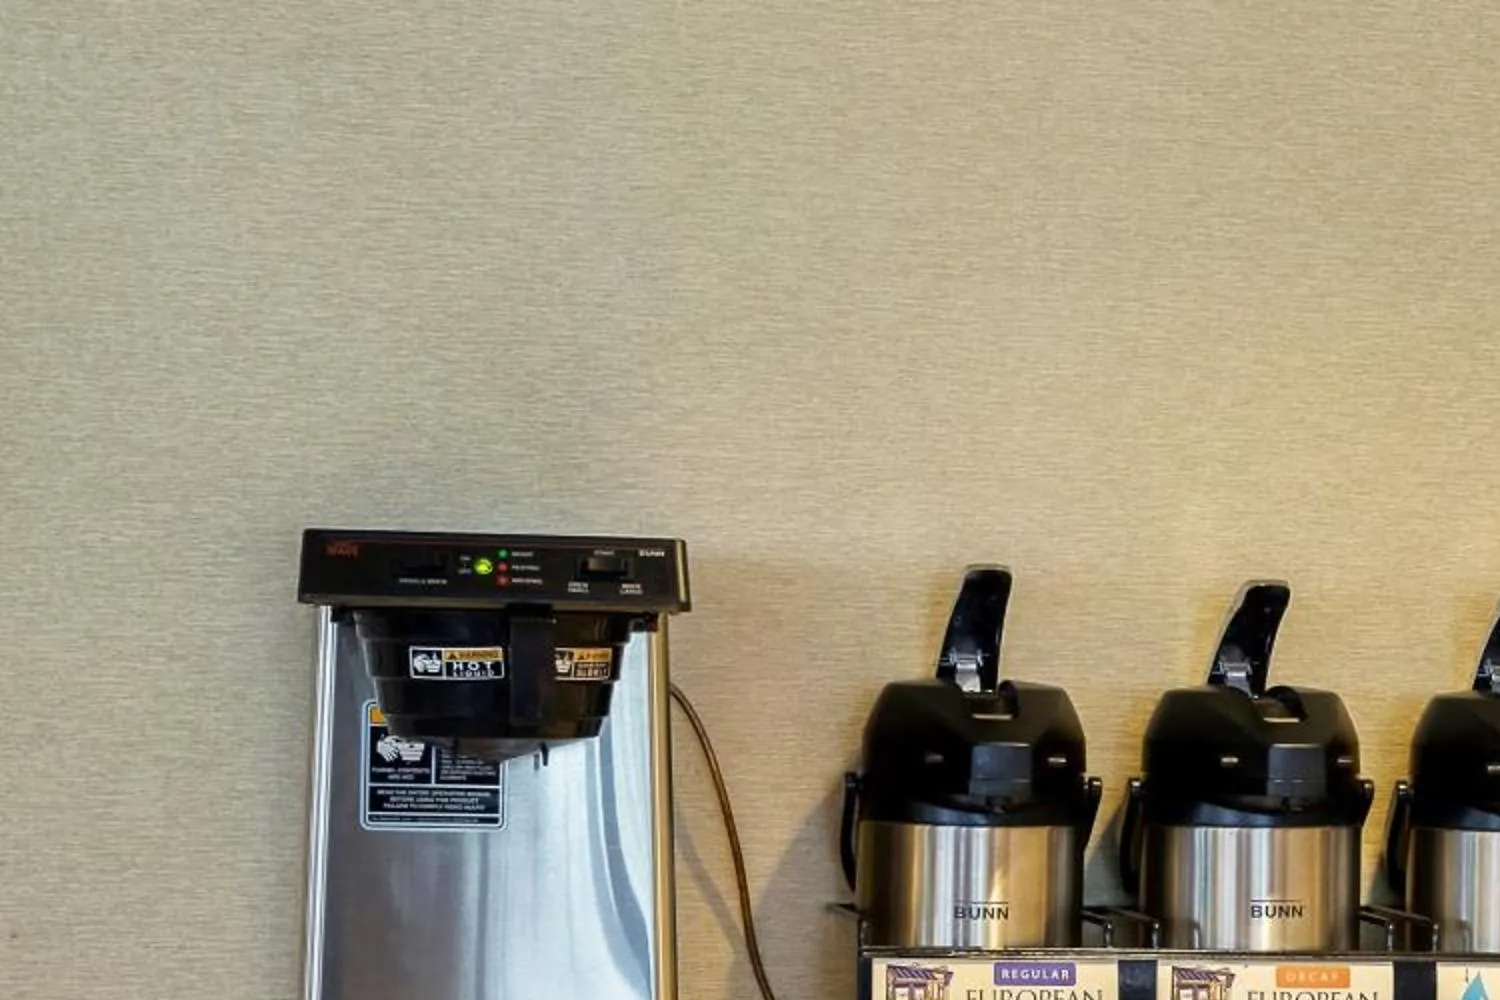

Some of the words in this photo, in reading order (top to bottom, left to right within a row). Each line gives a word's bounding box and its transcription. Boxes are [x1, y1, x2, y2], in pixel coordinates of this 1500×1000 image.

[453, 661, 493, 671] HOT
[954, 905, 1009, 920] BUNN
[1251, 904, 1303, 918] BUNN
[1001, 968, 1070, 982] REGULAR
[1284, 971, 1341, 983] DECAF
